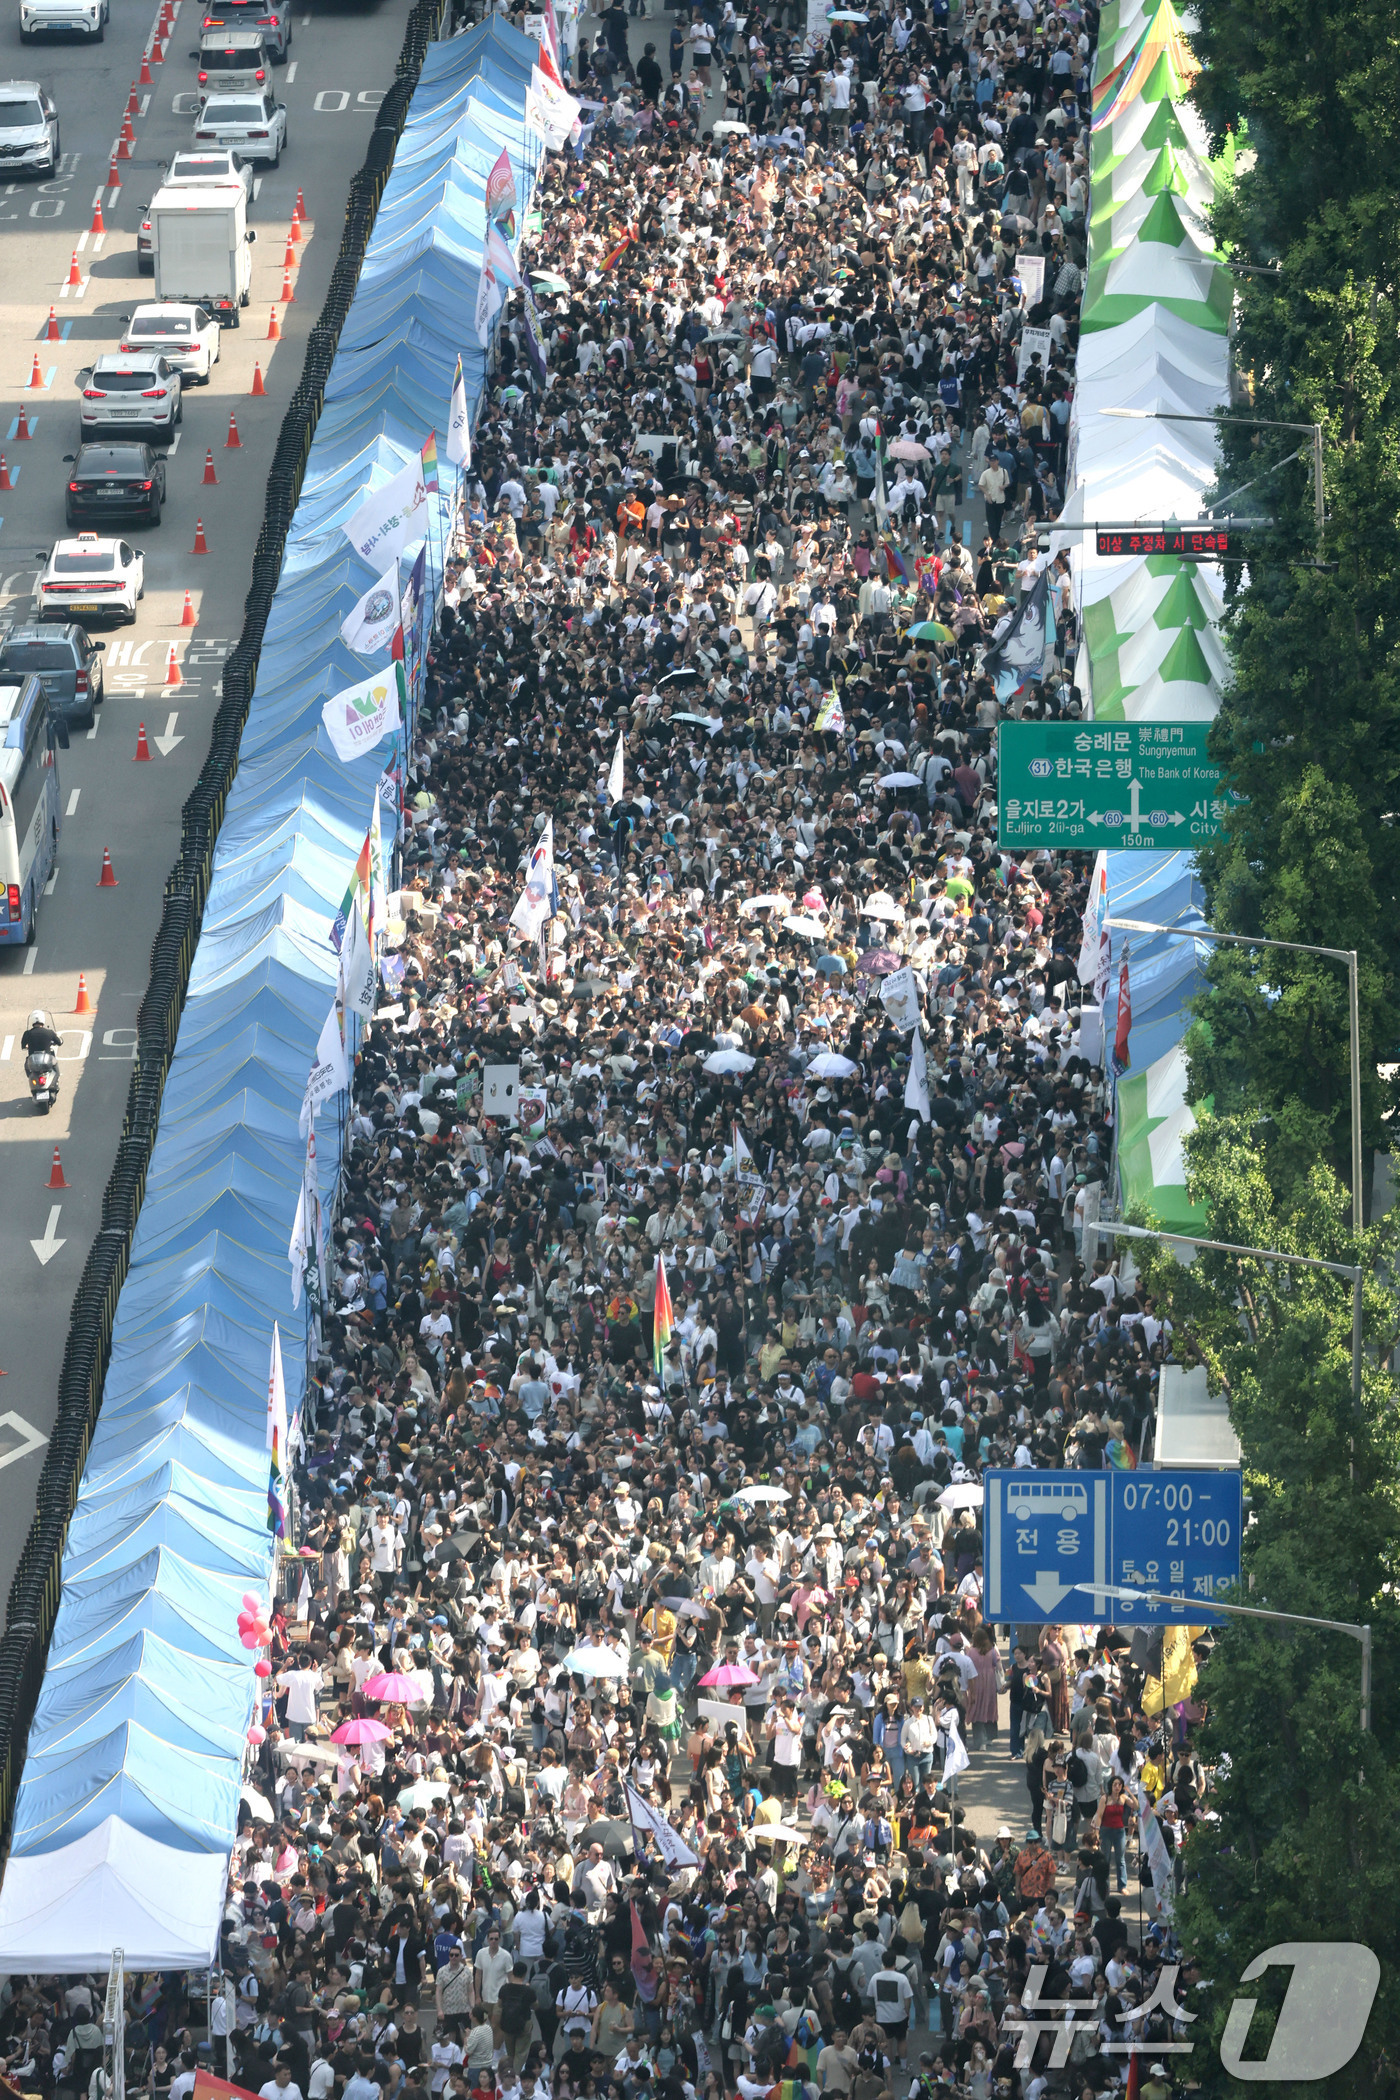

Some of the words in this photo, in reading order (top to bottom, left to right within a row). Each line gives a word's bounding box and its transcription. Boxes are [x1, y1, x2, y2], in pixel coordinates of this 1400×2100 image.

[1100, 536, 1123, 552] 이상
[1130, 535, 1166, 552] 주정차
[1173, 534, 1185, 551] 시
[1074, 732, 1132, 752] 숭례문
[1138, 727, 1183, 743] 崇禮門
[1138, 745, 1197, 758] Sungnyemun
[1033, 761, 1048, 774] 31
[1055, 758, 1133, 779] 한국은행
[1139, 767, 1156, 779] The
[1158, 767, 1181, 779] Bank
[1182, 767, 1191, 779] of
[1193, 767, 1220, 779] Korea
[1005, 799, 1085, 819] 을지로2가
[1190, 800, 1227, 819] 시청
[1106, 812, 1120, 825] 60
[1152, 812, 1166, 825] 60
[1006, 822, 1042, 836] Euljiro
[1049, 822, 1084, 837] 2(i)-ga
[1190, 822, 1217, 837] City
[1121, 834, 1154, 846] 150m
[1166, 1519, 1230, 1547] 21:00
